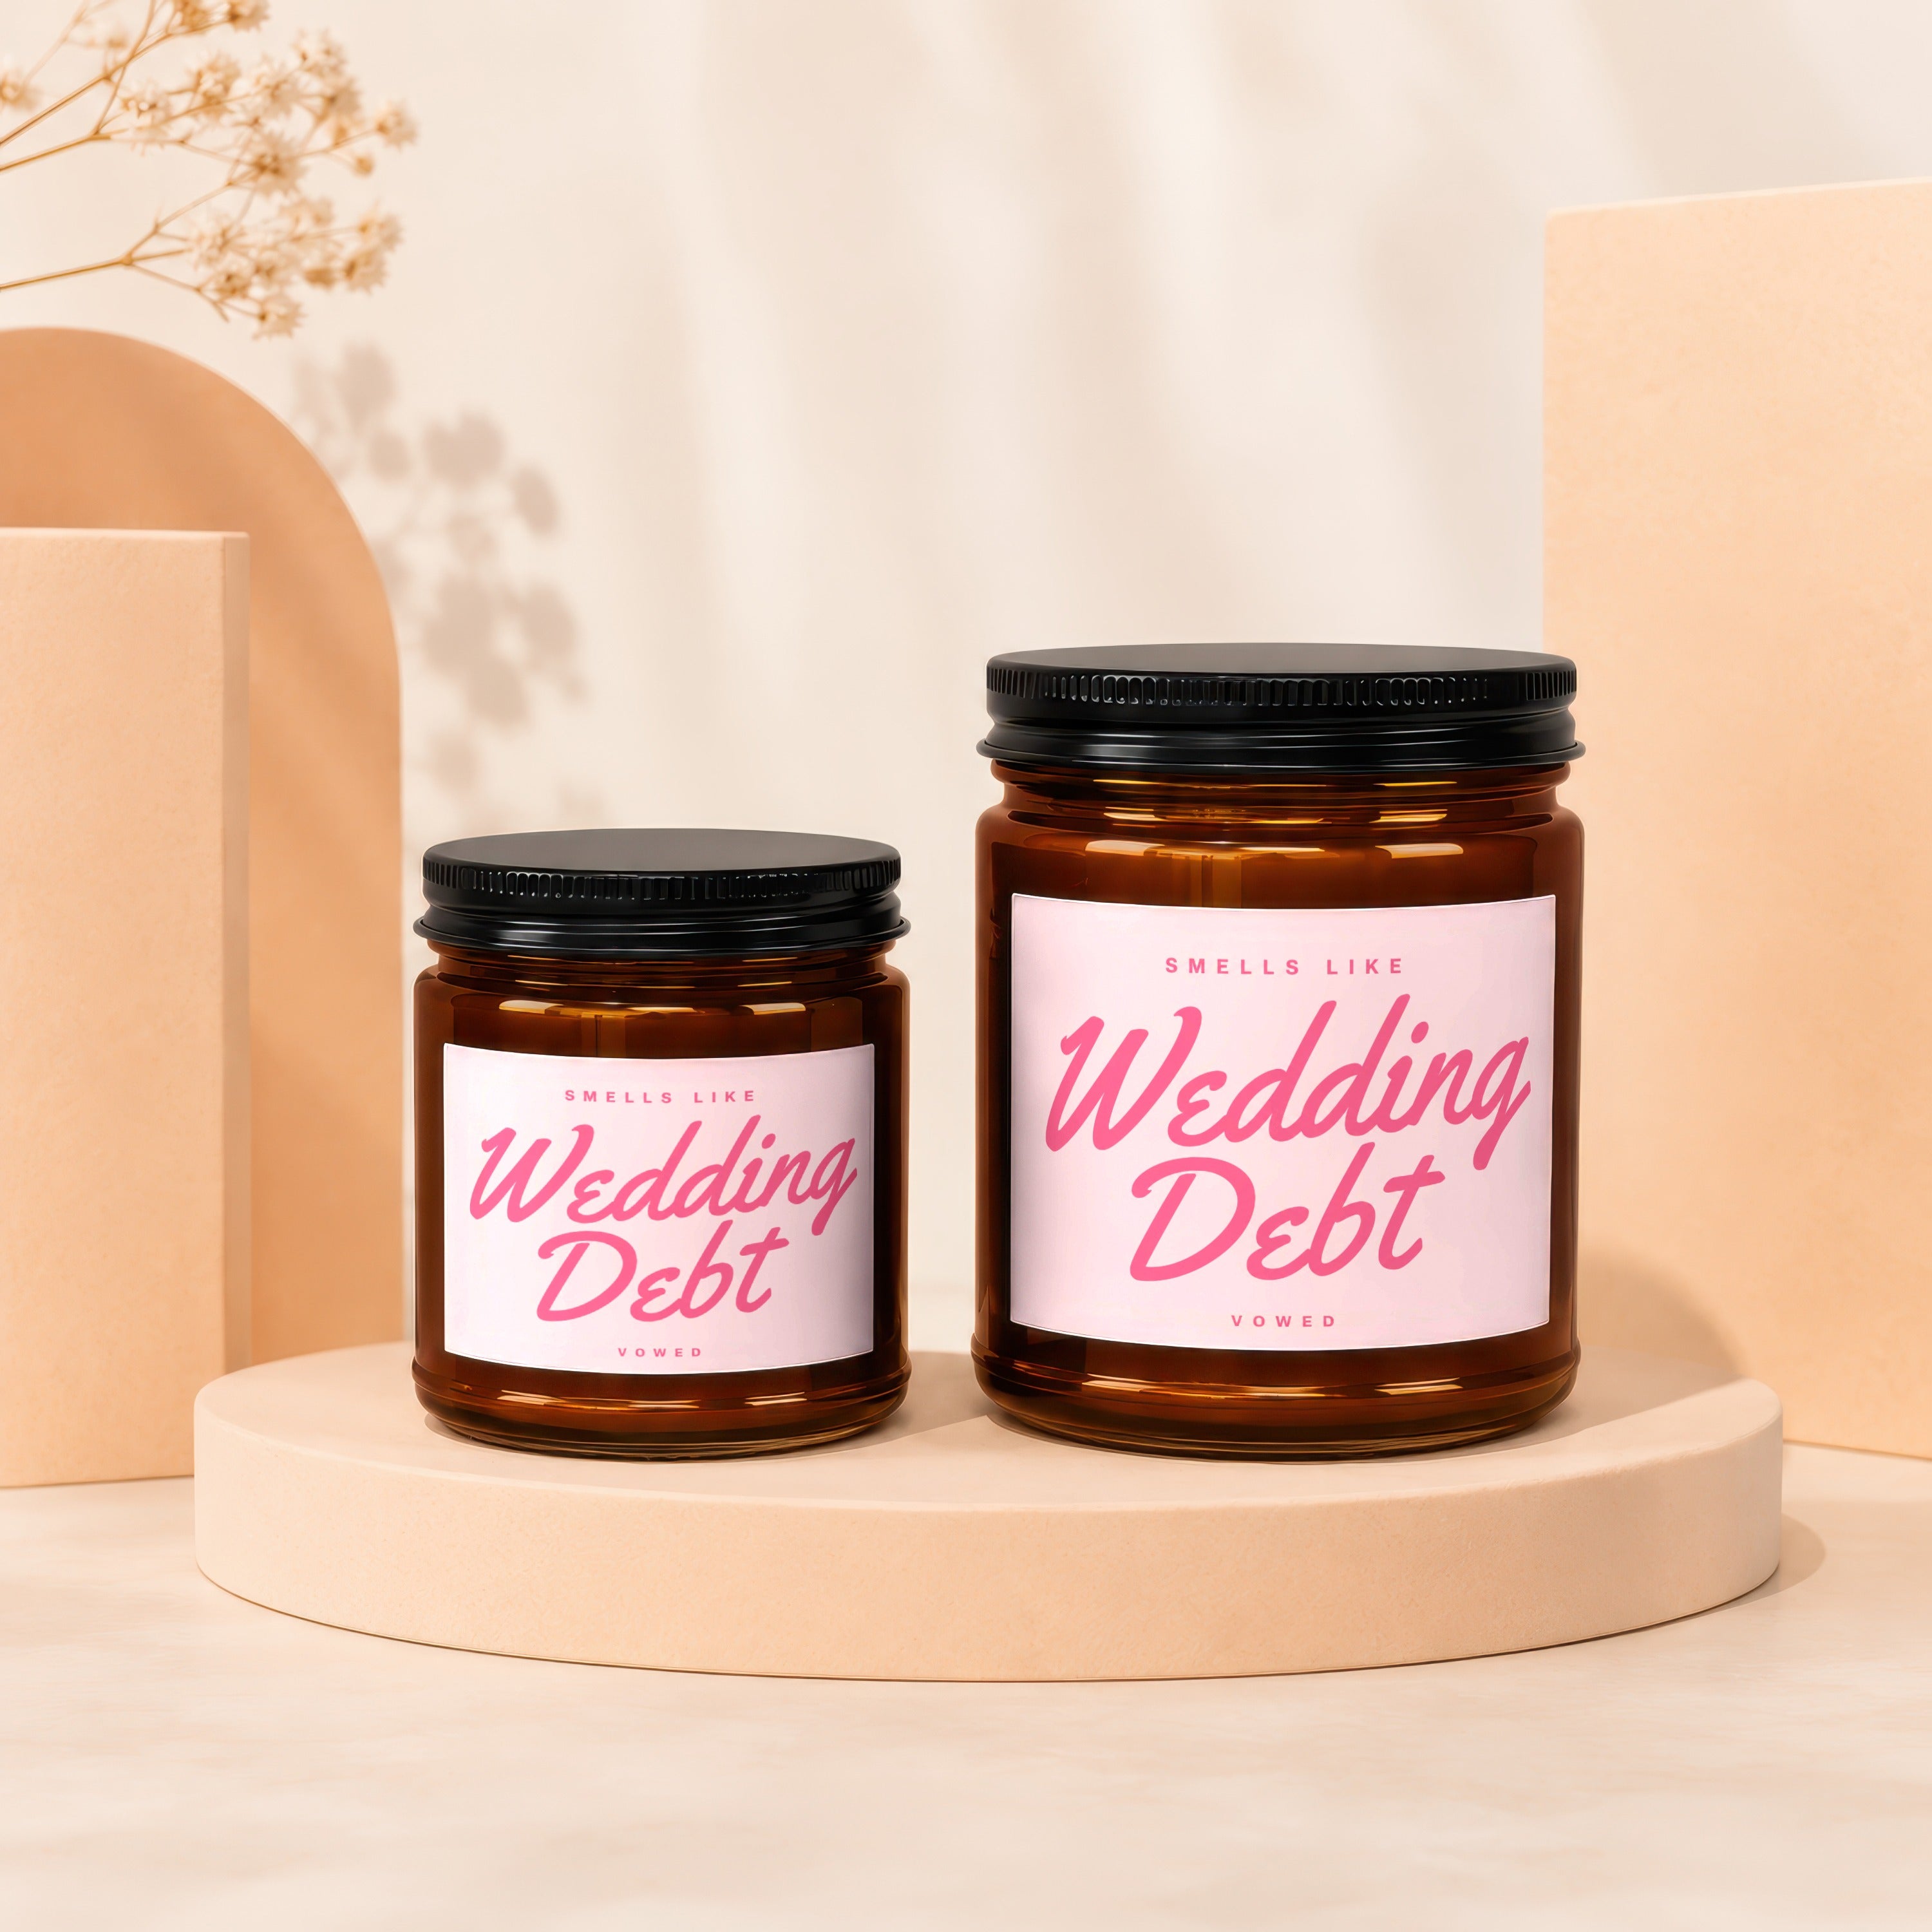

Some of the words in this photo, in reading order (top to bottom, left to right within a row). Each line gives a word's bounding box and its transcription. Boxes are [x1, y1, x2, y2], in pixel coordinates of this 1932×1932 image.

[1165, 957, 1299, 976] SMELLS
[1327, 958, 1403, 976] LIKE
[565, 1090, 672, 1104] SMELLS
[694, 1090, 754, 1104] LIKE
[1045, 993, 1532, 1171] Wedding
[469, 1113, 858, 1236] Wedding
[1129, 1141, 1446, 1282] Debt
[536, 1218, 790, 1323] Debt
[1231, 1314, 1335, 1328] VOWED
[618, 1347, 701, 1358] VOWED
